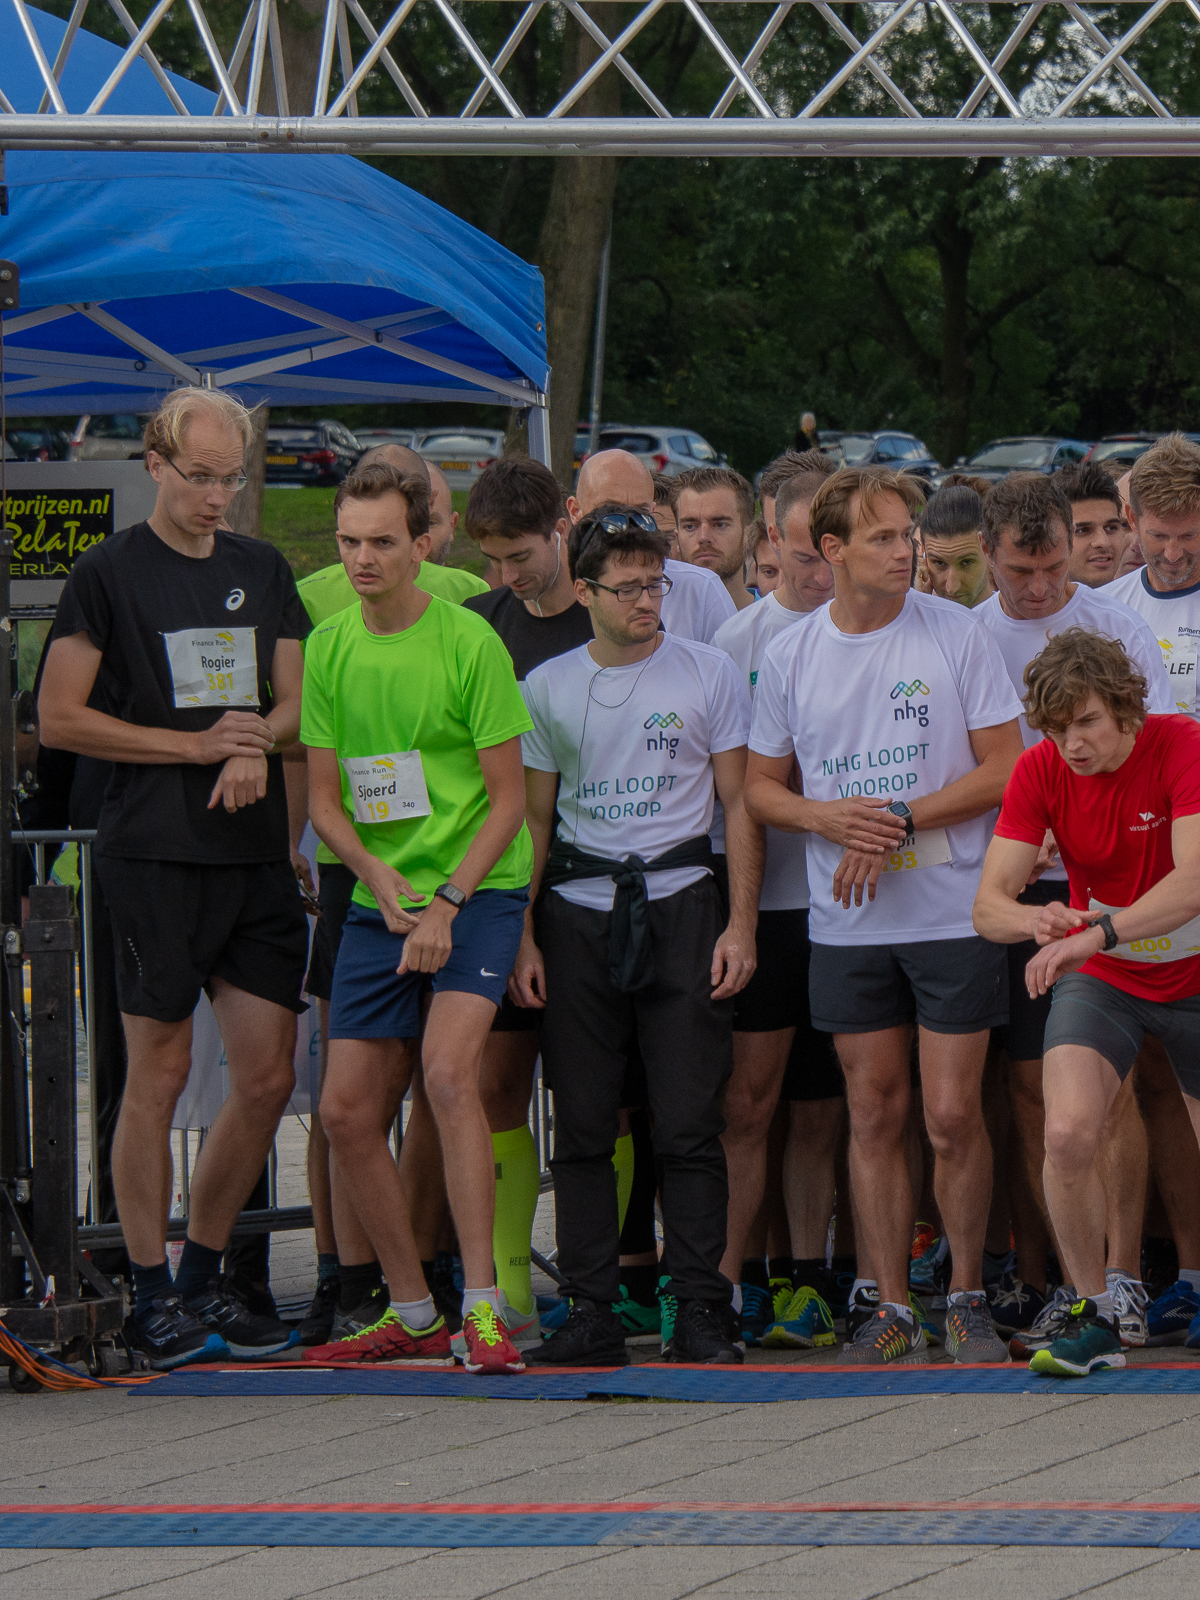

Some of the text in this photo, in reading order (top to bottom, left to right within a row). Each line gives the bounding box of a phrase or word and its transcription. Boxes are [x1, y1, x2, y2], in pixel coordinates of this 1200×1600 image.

[0, 494, 110, 520] tprijzen.nl
[10, 563, 75, 575] ERLA
[200, 655, 236, 671] Rogier
[1169, 662, 1195, 675] LEF
[206, 673, 234, 690] 381
[893, 699, 930, 728] nhg
[646, 730, 679, 760] nhg
[822, 743, 930, 777] NHG LOOPT
[357, 780, 397, 801] Sjoerd
[615, 775, 678, 795] LOOPT
[838, 772, 918, 800] VOOROP
[367, 801, 389, 820] 19
